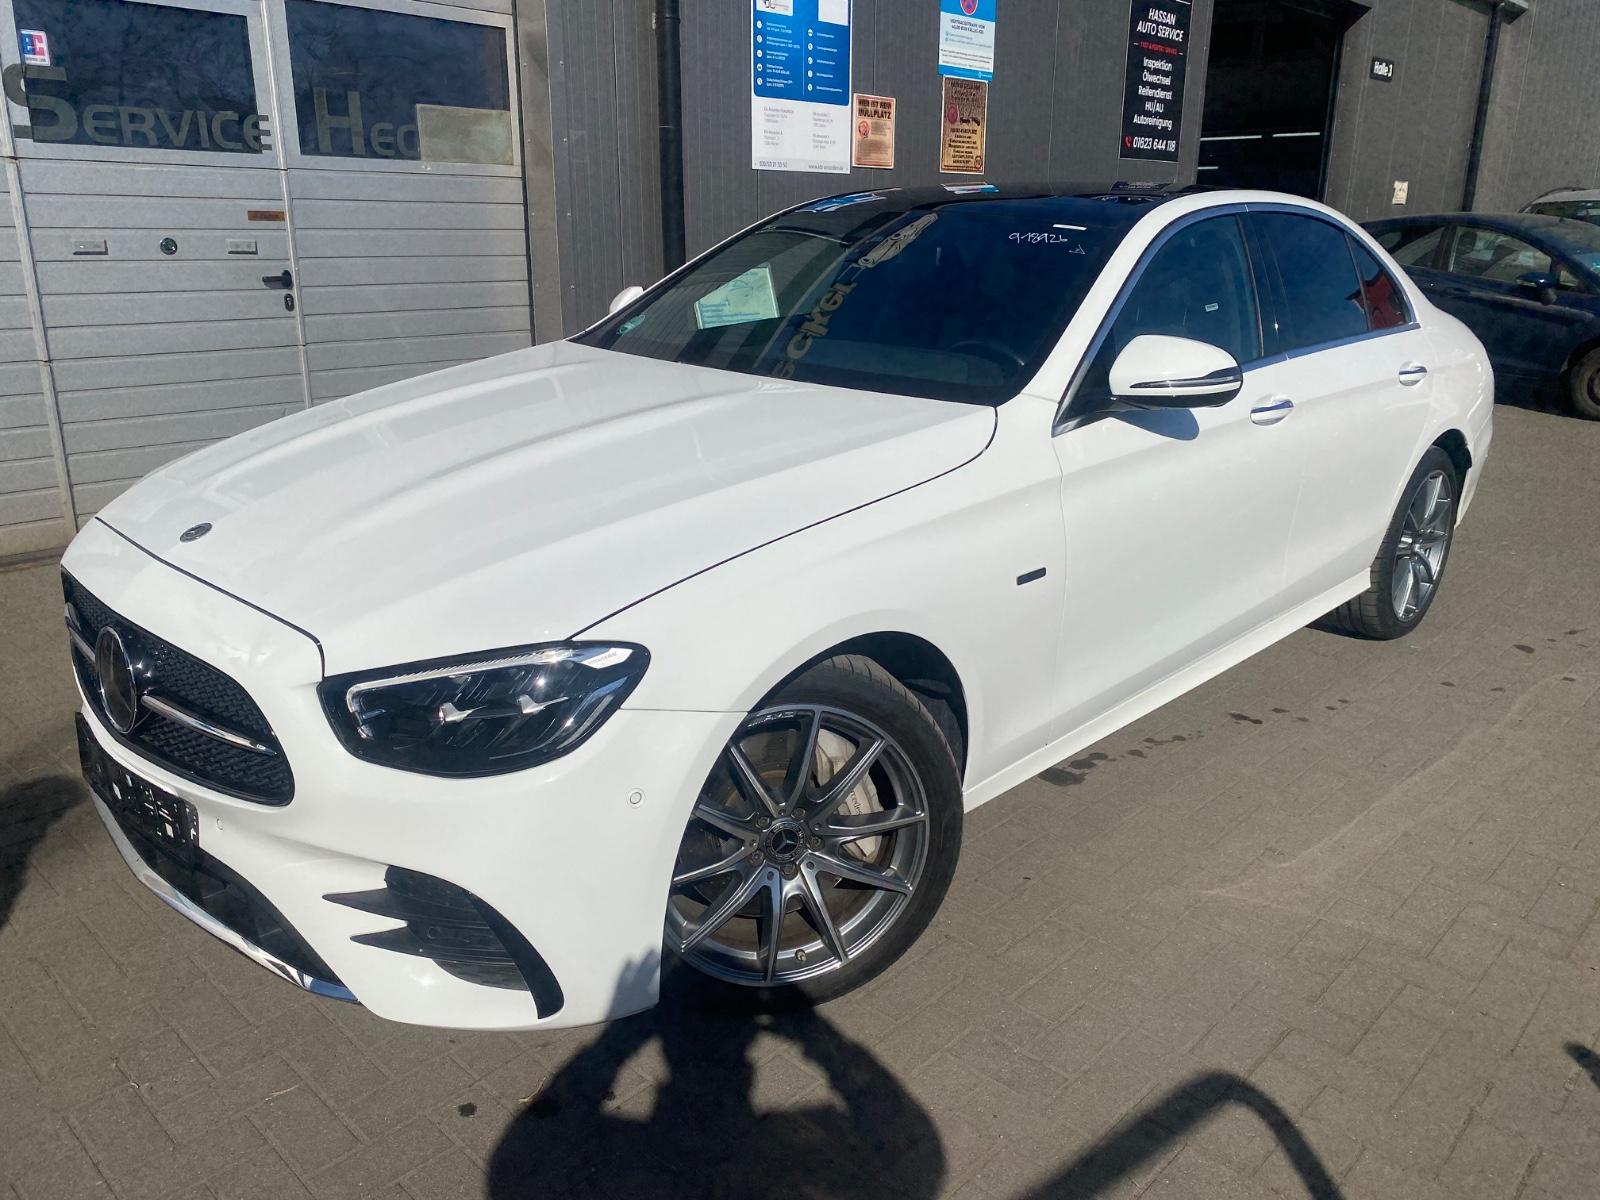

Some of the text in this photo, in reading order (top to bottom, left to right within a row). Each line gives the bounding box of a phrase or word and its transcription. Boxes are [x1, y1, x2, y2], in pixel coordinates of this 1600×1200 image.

[1149, 8, 1176, 25] HASSAN
[1136, 21, 1185, 42] AUTO SERVICE
[1143, 57, 1173, 72] Inspektion
[1374, 62, 1388, 75] Halle
[1143, 70, 1172, 85] Ölwechsel
[1138, 85, 1173, 100] Reifendienst
[1145, 99, 1165, 114] HU/AU
[1133, 114, 1173, 130] Autoreinigung
[1153, 138, 1166, 151] 644
